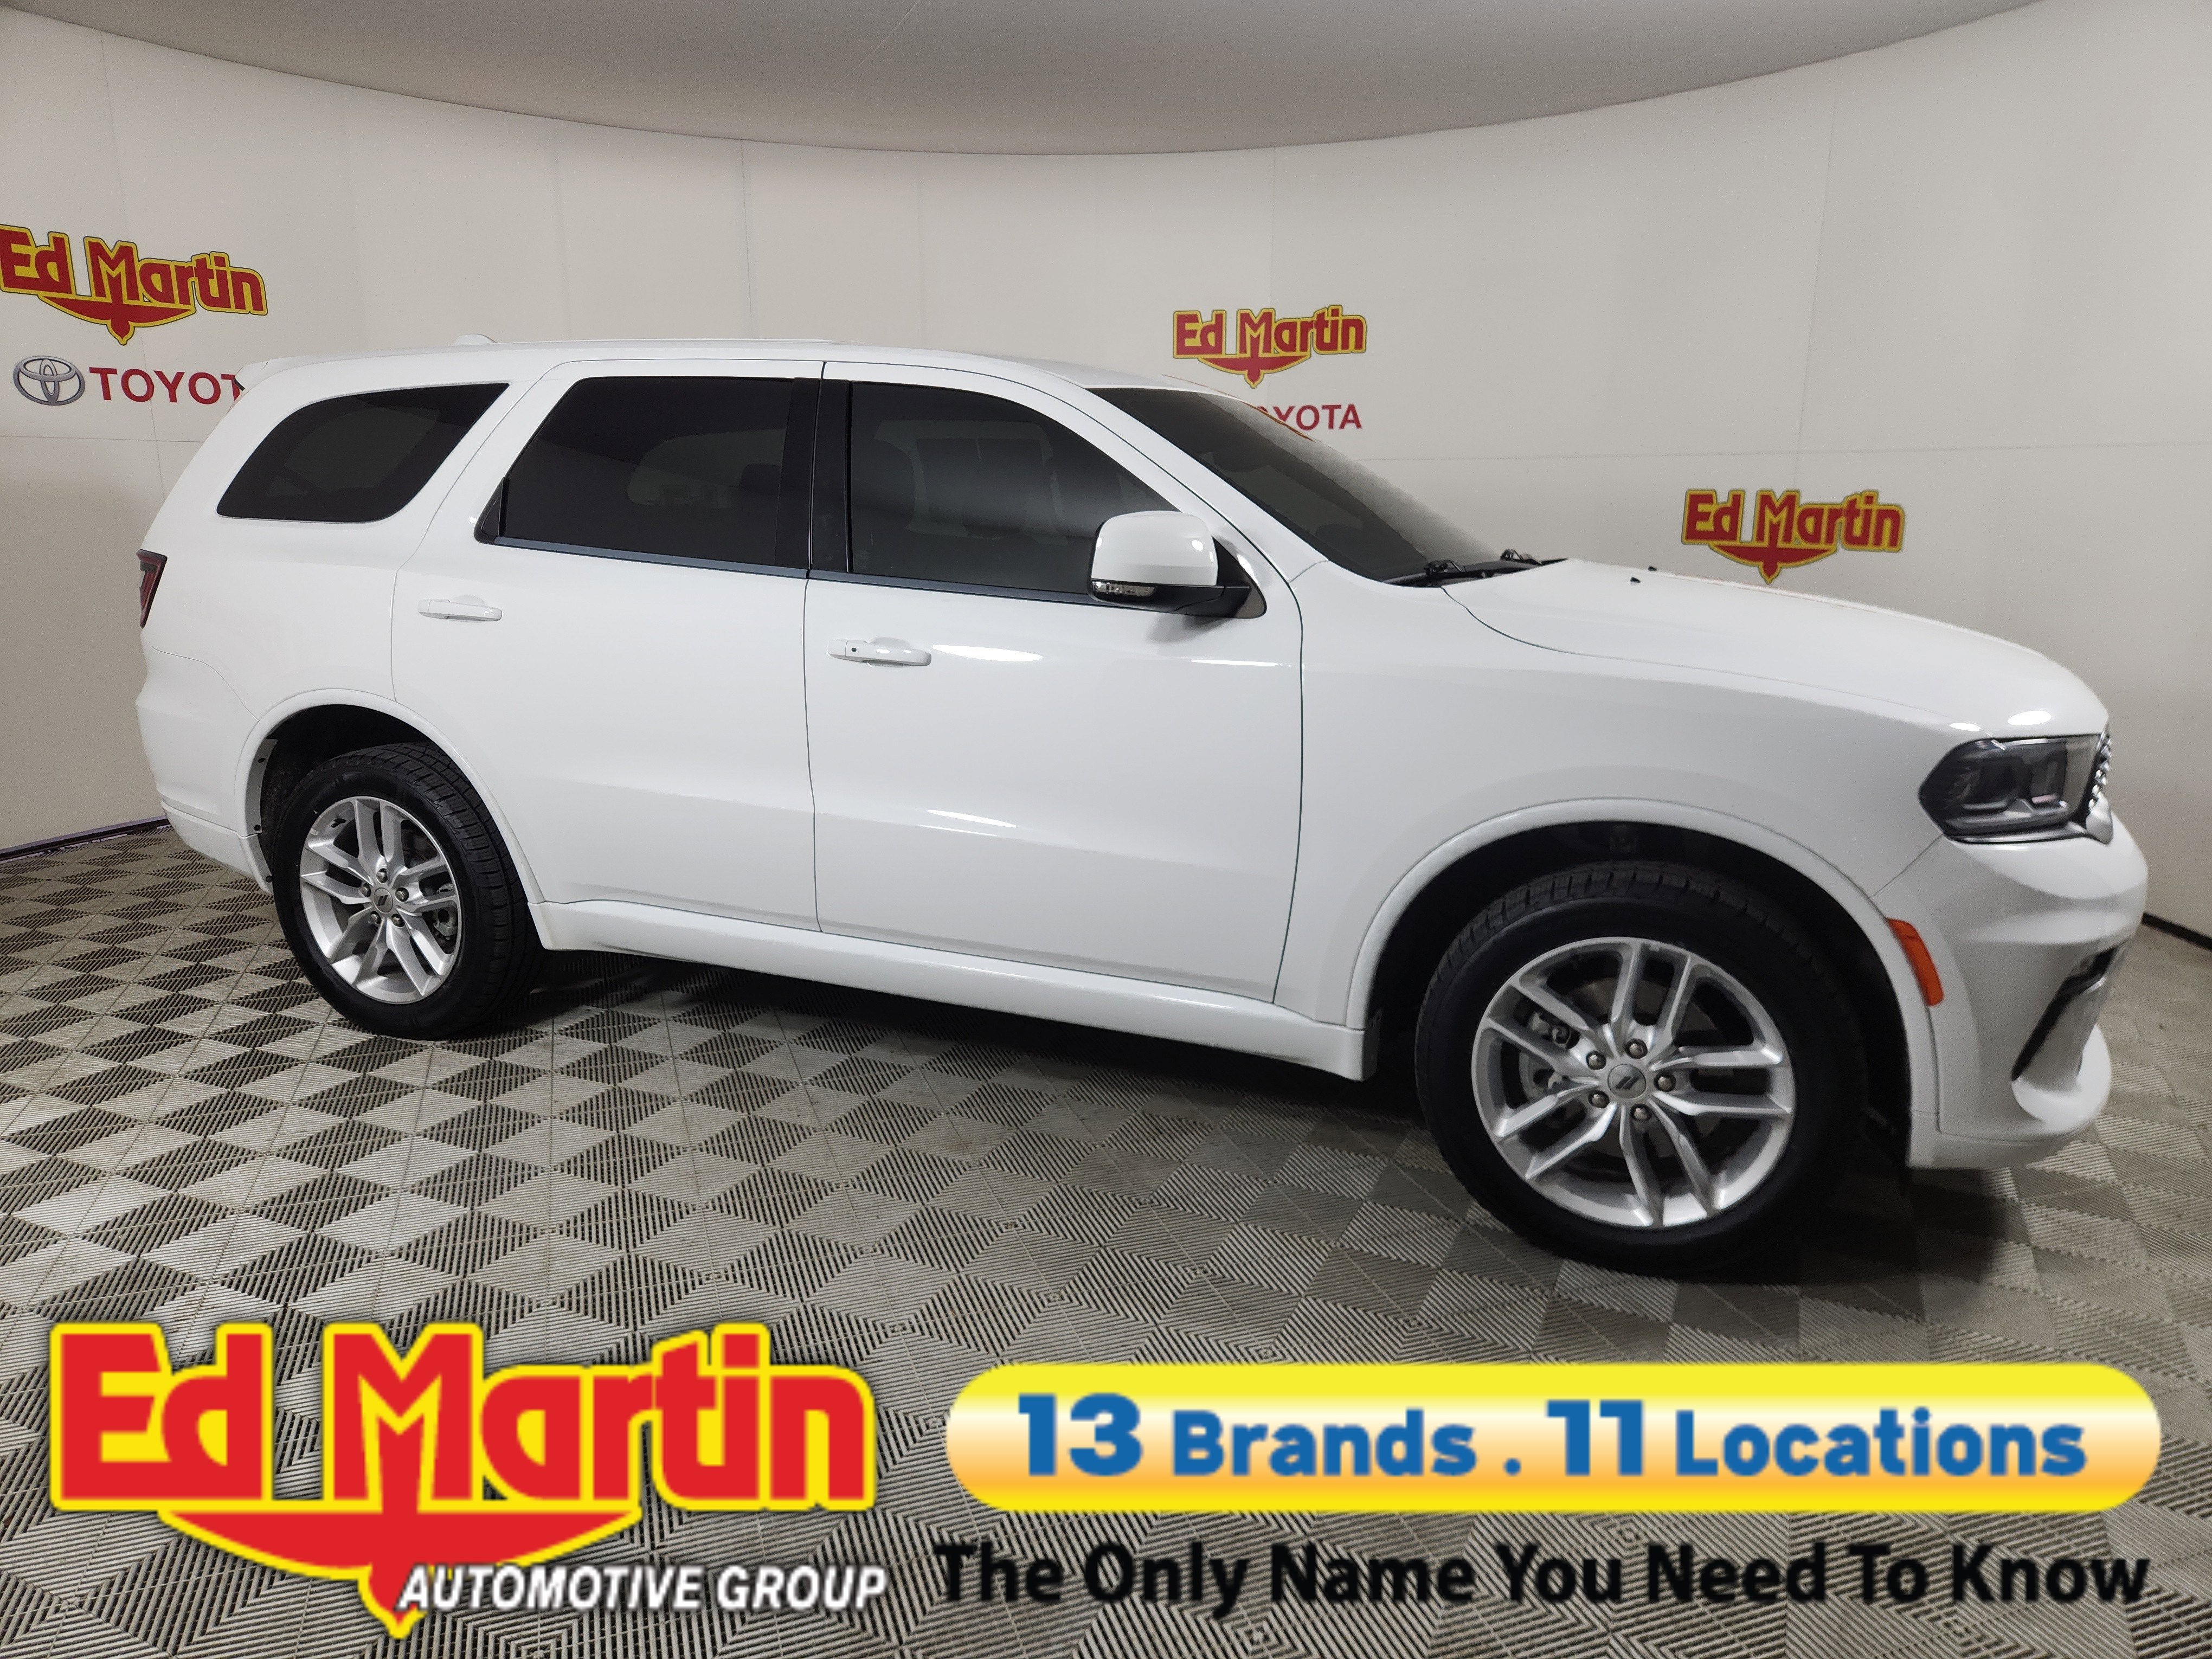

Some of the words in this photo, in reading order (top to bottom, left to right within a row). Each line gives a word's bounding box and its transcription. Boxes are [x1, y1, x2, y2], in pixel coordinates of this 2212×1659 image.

[0, 228, 73, 295] Ed
[87, 241, 265, 312] Martin
[1176, 312, 1224, 356] Ed
[1239, 308, 1364, 353] Martin
[89, 366, 242, 404] TOYOT
[1257, 403, 1362, 430] YOTA
[1685, 494, 1741, 542] Ed
[1756, 494, 1901, 548] Martin
